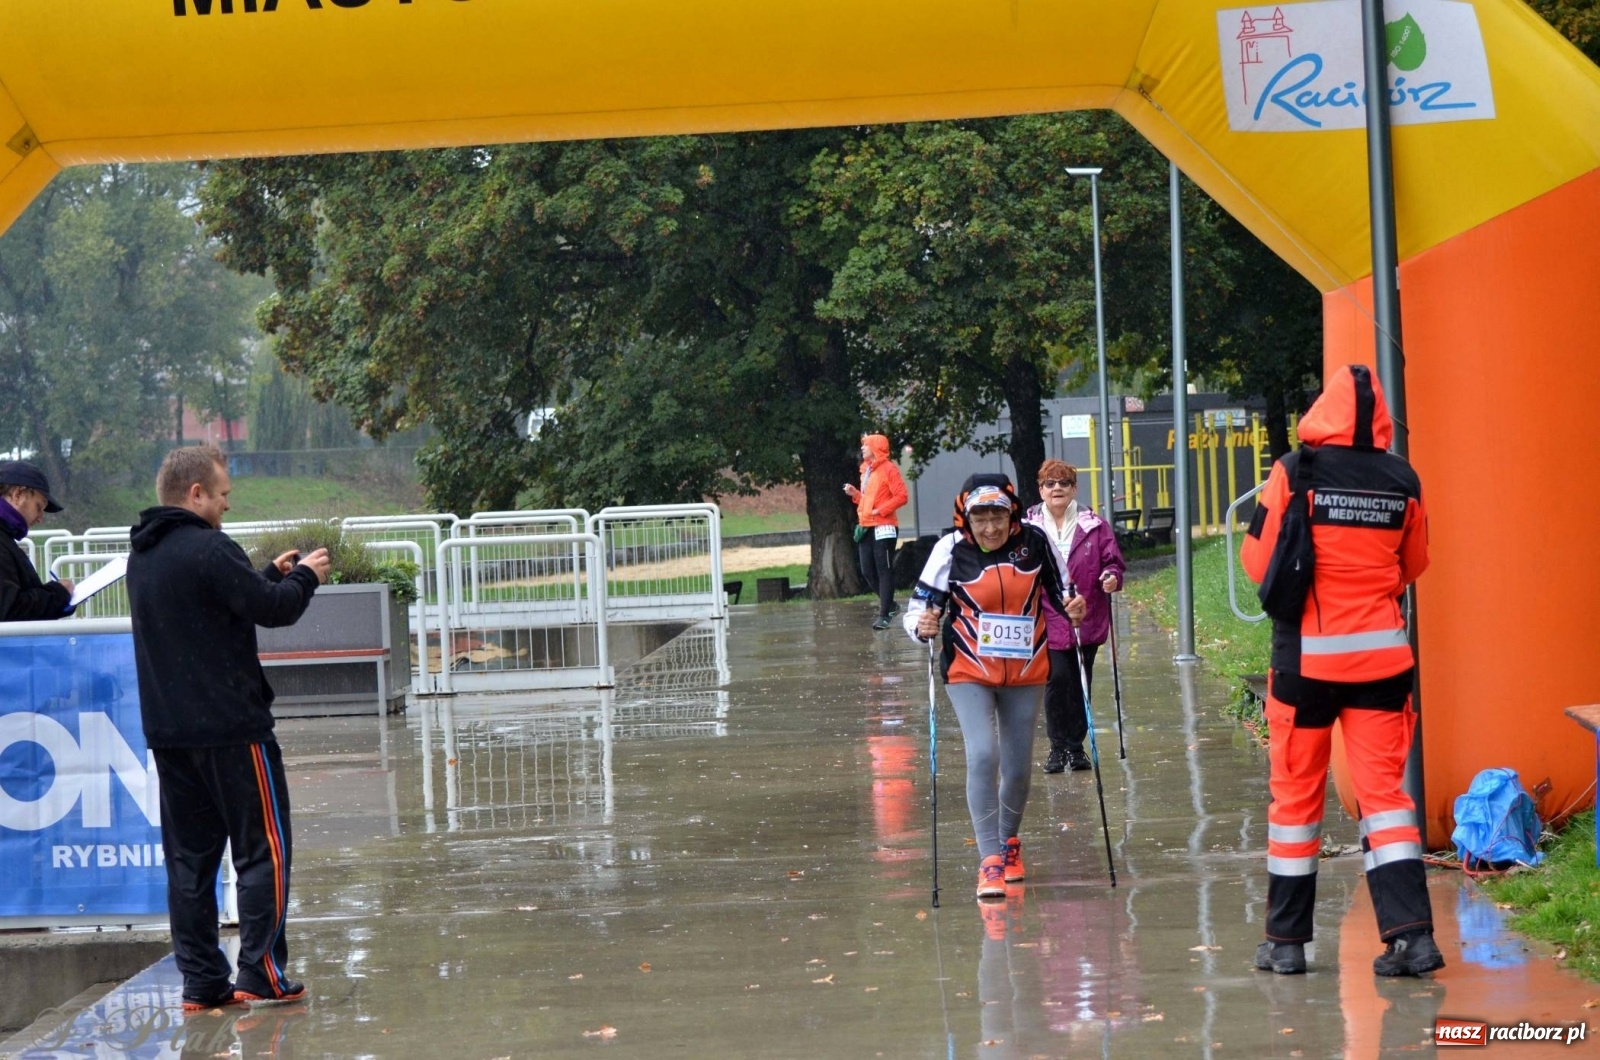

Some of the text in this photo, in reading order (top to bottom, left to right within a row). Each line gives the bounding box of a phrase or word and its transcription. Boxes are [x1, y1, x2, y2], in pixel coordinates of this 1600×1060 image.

[1390, 45, 1402, 58] ISO
[1253, 53, 1477, 129] Raciórz
[1166, 428, 1220, 451] Paża
[1314, 493, 1406, 512] RATOWNICTWO
[1328, 508, 1391, 523] MEDYCZNE
[993, 625, 1022, 640] 015
